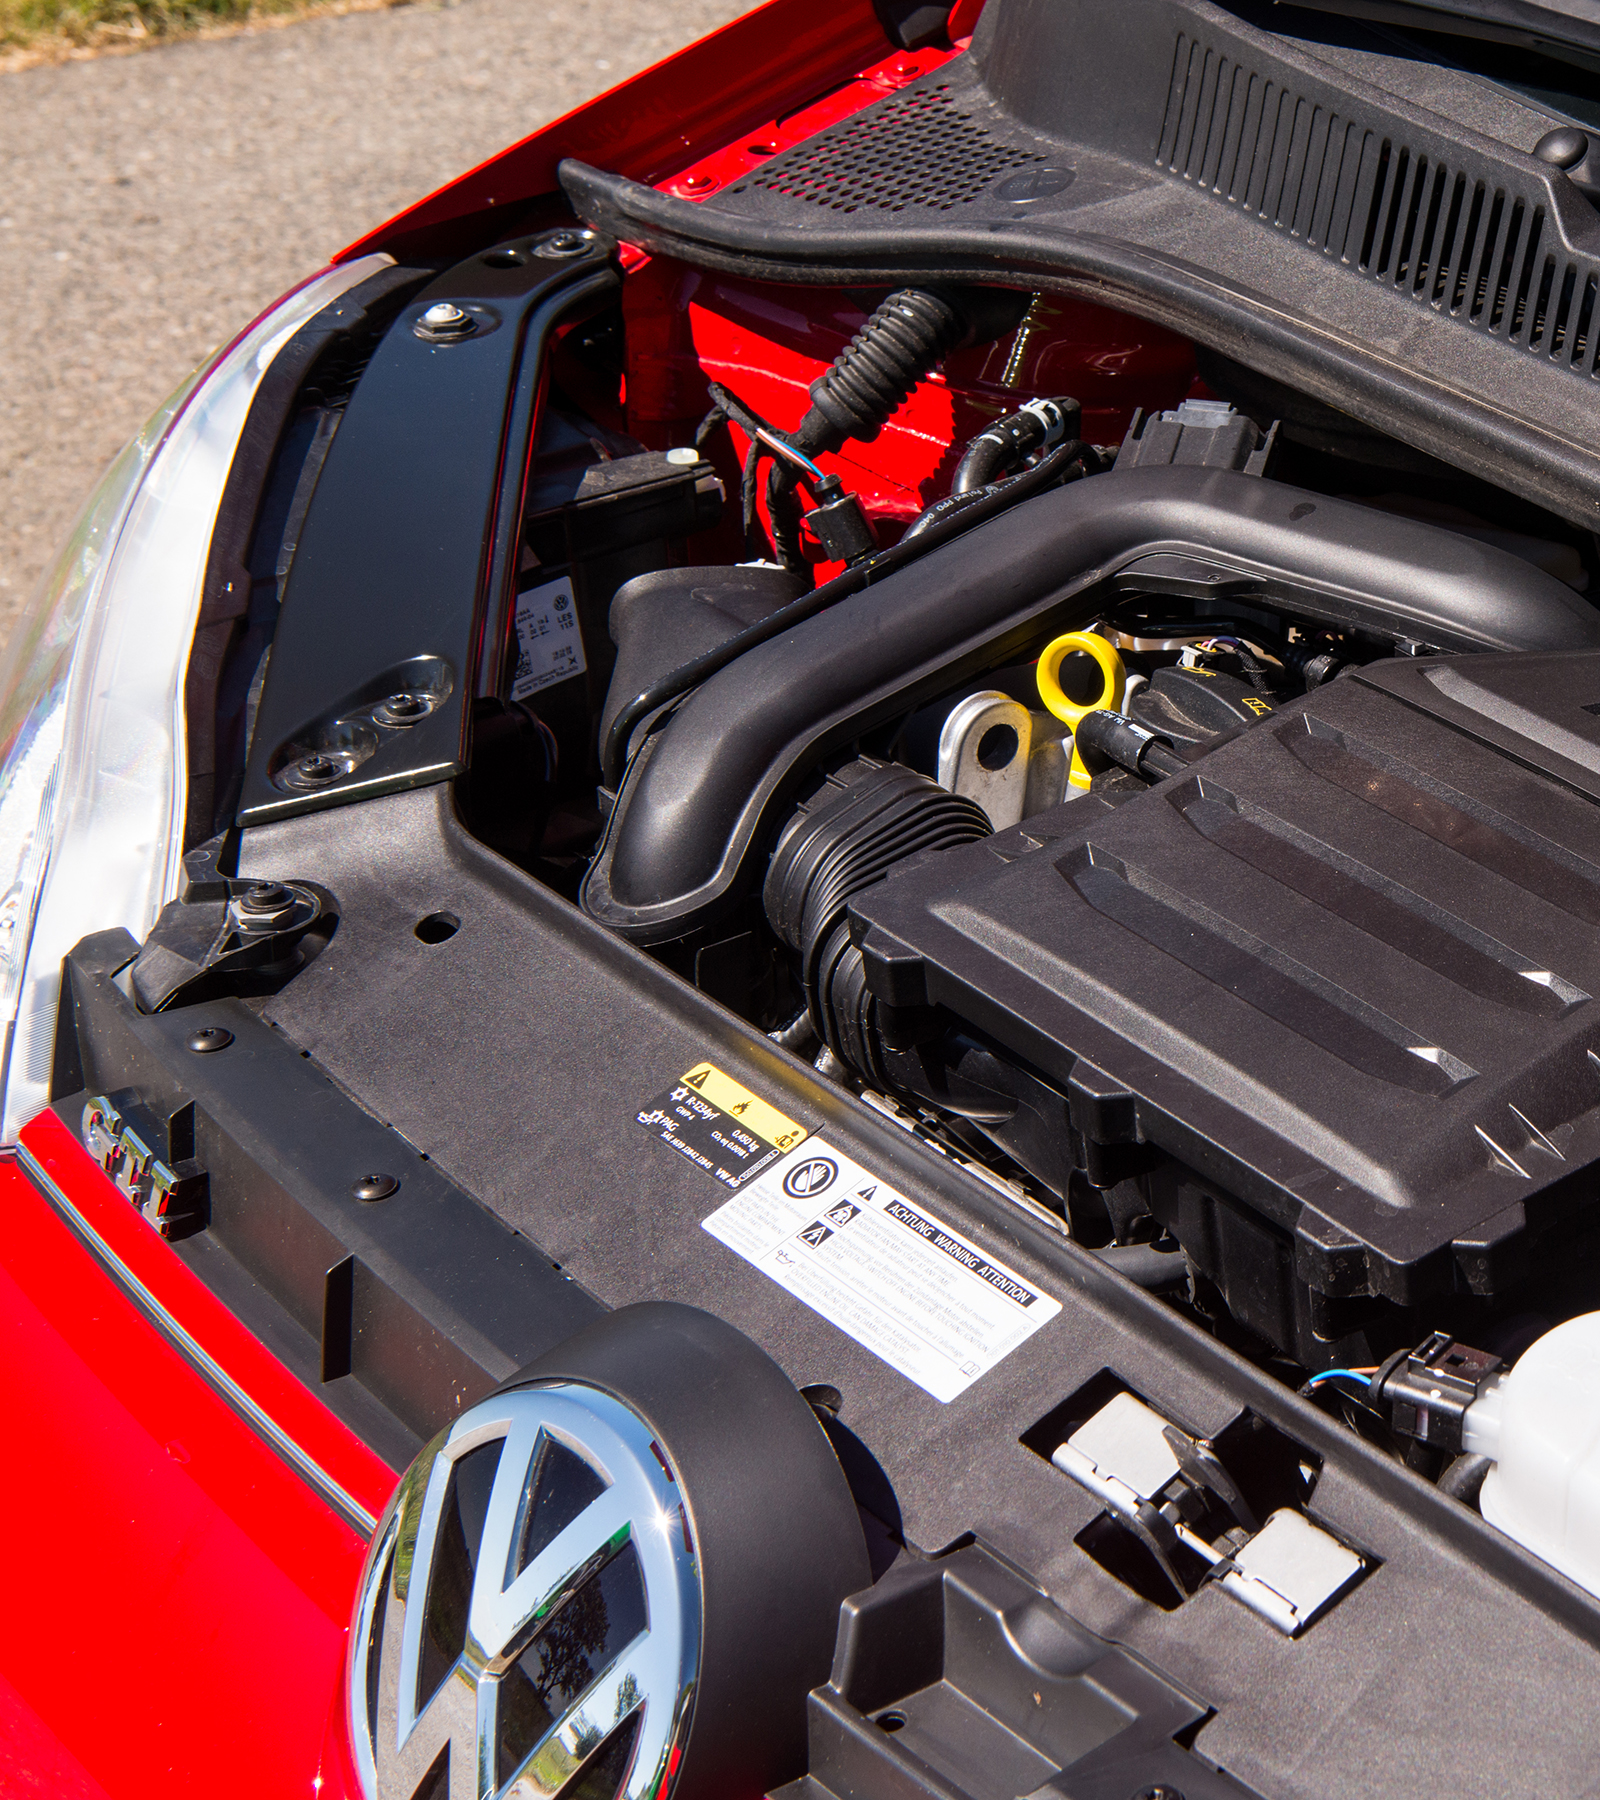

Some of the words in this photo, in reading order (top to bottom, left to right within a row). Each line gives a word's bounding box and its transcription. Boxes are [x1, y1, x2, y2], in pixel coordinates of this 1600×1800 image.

[557, 612, 573, 623] LES
[675, 1105, 691, 1117] GWP
[685, 1096, 720, 1120] R-1234yf
[659, 1116, 679, 1132] PAG
[660, 1130, 674, 1141] SAE
[731, 1129, 752, 1145] 0.450
[747, 1140, 760, 1152] kg
[81, 1096, 179, 1238] GTI
[715, 1167, 731, 1180] VW
[725, 1176, 741, 1188] AG
[853, 1218, 881, 1238] RADIATOR
[877, 1235, 892, 1246] FAN
[888, 1242, 904, 1254] MAY
[900, 1251, 919, 1265] START
[915, 1262, 926, 1270] AT
[922, 1267, 938, 1277] ANY
[888, 1204, 934, 1236] ACHTUNG
[934, 1234, 979, 1267] WARNING
[977, 1266, 1030, 1302] ATTENTION
[790, 1268, 822, 1291] OVERFILLED
[818, 1288, 841, 1305] ENGINE
[848, 1309, 863, 1321] CAN
[859, 1317, 885, 1337] DAMAGE
[828, 1238, 845, 1251] HIGH
[865, 1264, 888, 1281] SWITCH
[884, 1278, 898, 1287] OFF
[895, 1285, 917, 1302] ENGINE
[914, 1299, 936, 1316] BEFORE
[934, 1313, 965, 1336] TOUCHING
[962, 1332, 989, 1353] IGNITION
